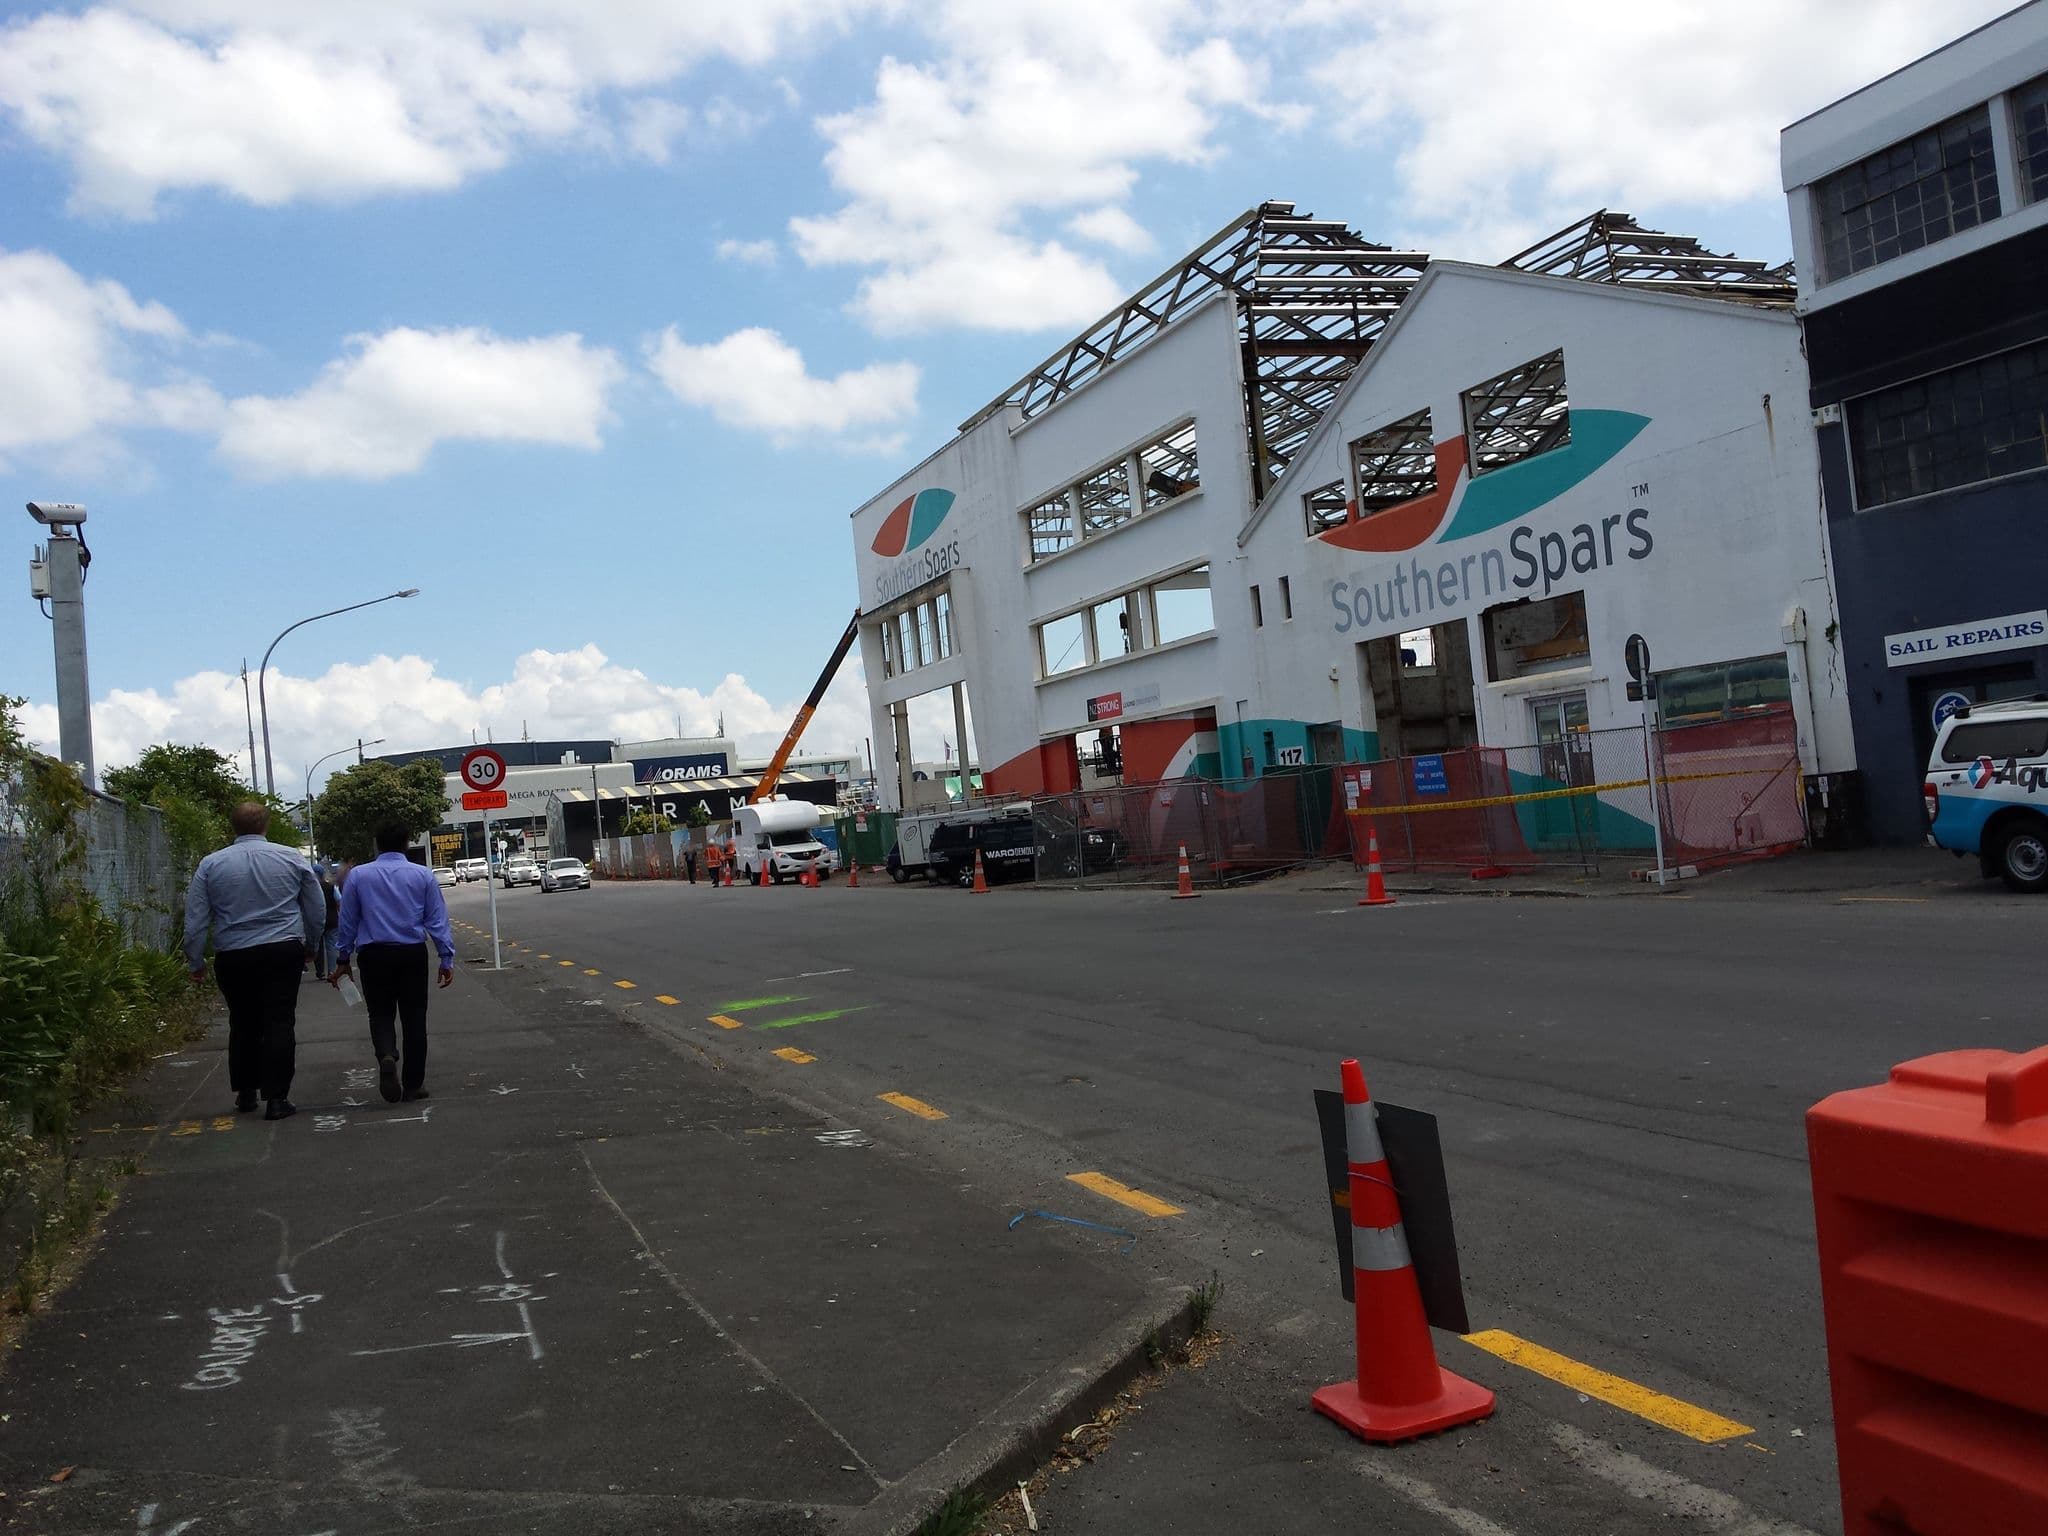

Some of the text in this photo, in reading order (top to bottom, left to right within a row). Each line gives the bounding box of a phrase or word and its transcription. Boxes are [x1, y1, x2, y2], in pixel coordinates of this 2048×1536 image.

[1890, 621, 2045, 656] SAIL REPAIRS
[1281, 749, 1302, 764] 117
[472, 763, 495, 779] 30
[661, 764, 722, 781] ORAMS
[509, 791, 535, 800] MEGA
